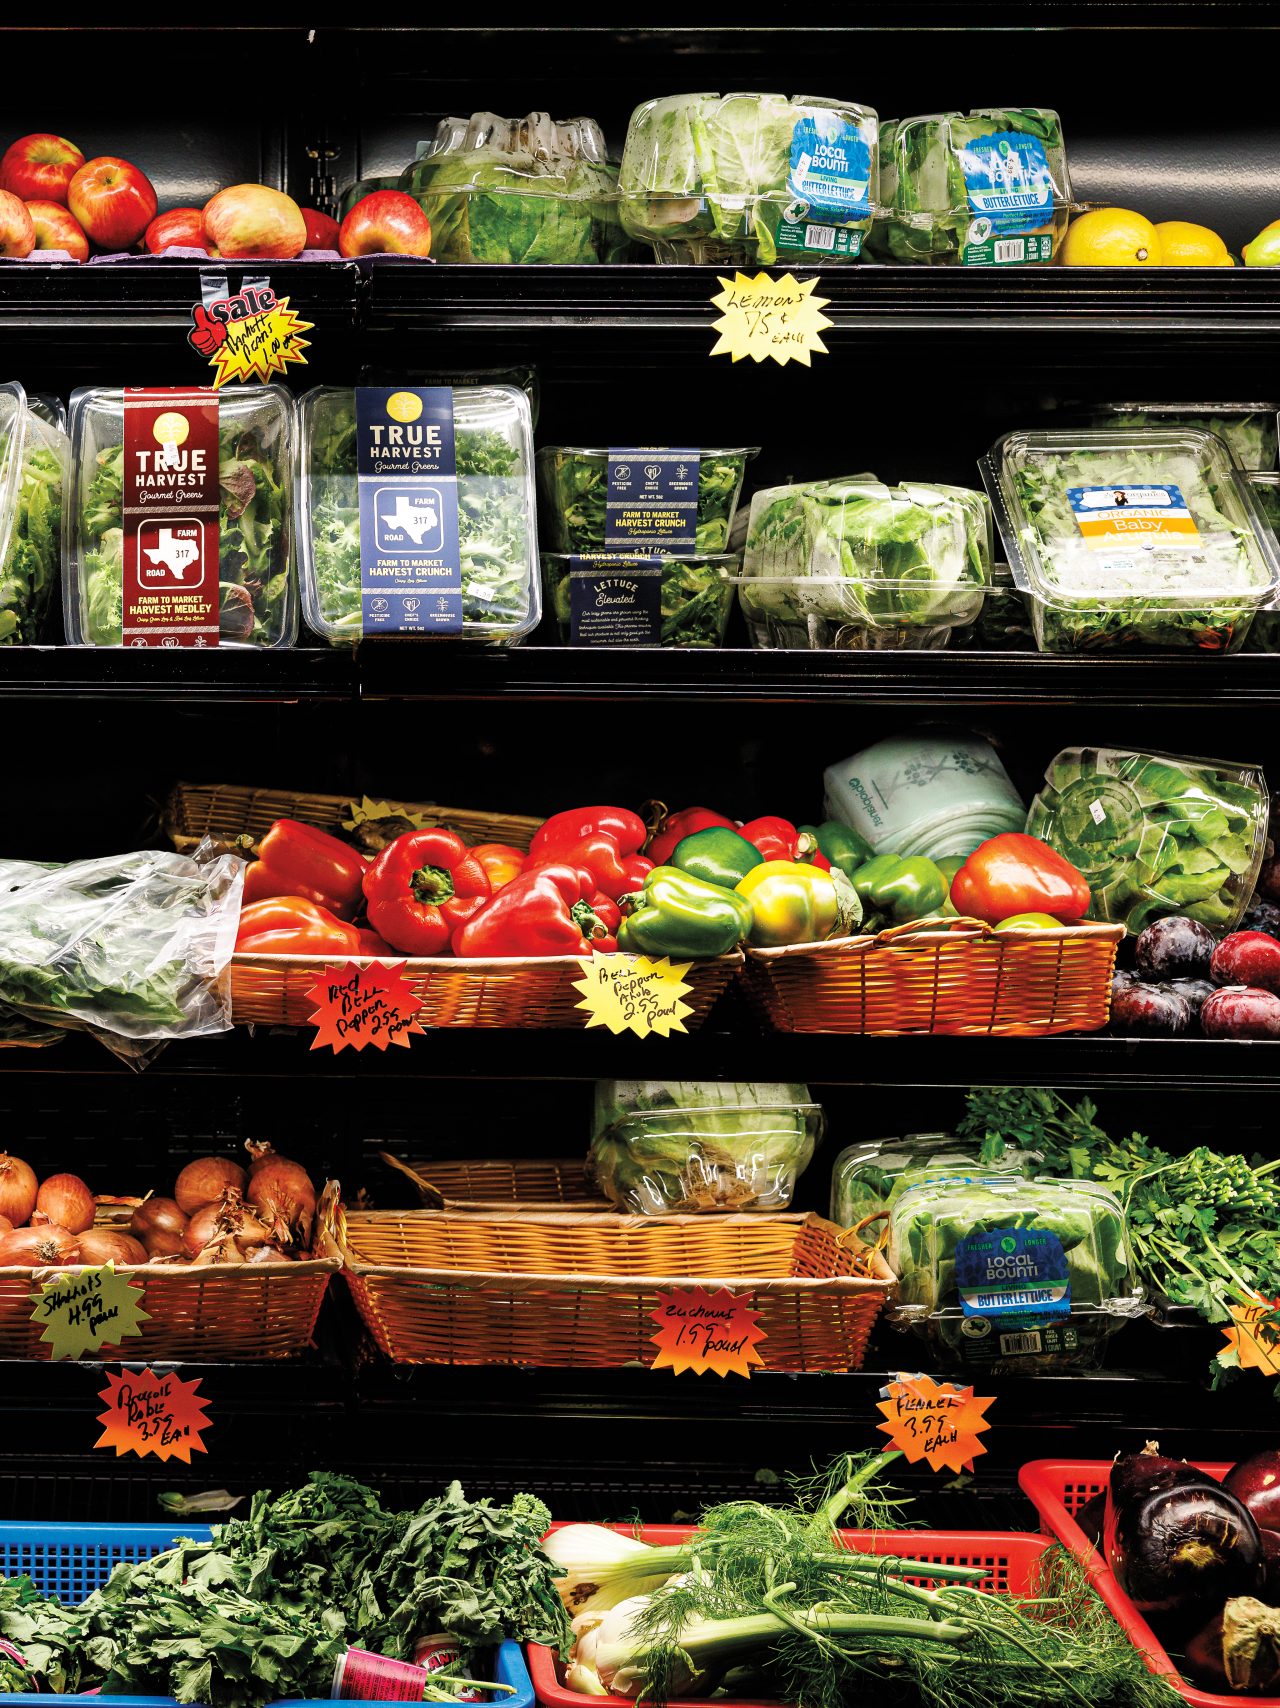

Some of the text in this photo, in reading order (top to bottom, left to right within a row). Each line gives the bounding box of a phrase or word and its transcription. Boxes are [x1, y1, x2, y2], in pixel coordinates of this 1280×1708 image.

[211, 289, 277, 323] Sale
[727, 290, 804, 309] LEMONS
[369, 425, 443, 446] TRUE
[369, 446, 443, 458] HARVEST
[374, 460, 440, 474] Gourmet Greens
[135, 473, 207, 487] HARVEST
[139, 488, 204, 504] Gourmet Greens
[413, 516, 428, 525] 317
[1097, 509, 1171, 519] ORGANIC
[615, 519, 687, 528] HARVEST CRUNCH
[1114, 518, 1163, 533] Baby
[177, 529, 198, 537] FARM
[175, 549, 190, 559] 317
[376, 559, 444, 567] FARM TO MARKET
[146, 569, 166, 577] ROAD
[369, 567, 453, 577] HARVEST CRUNCH
[593, 579, 639, 593] LETTUCE
[138, 595, 204, 605] FARM TO MARKET
[595, 593, 636, 607] Elevated
[129, 603, 213, 615] HARVEST MEDLEY
[675, 1322, 720, 1348] 1.99
[903, 1414, 949, 1439] 3.99
